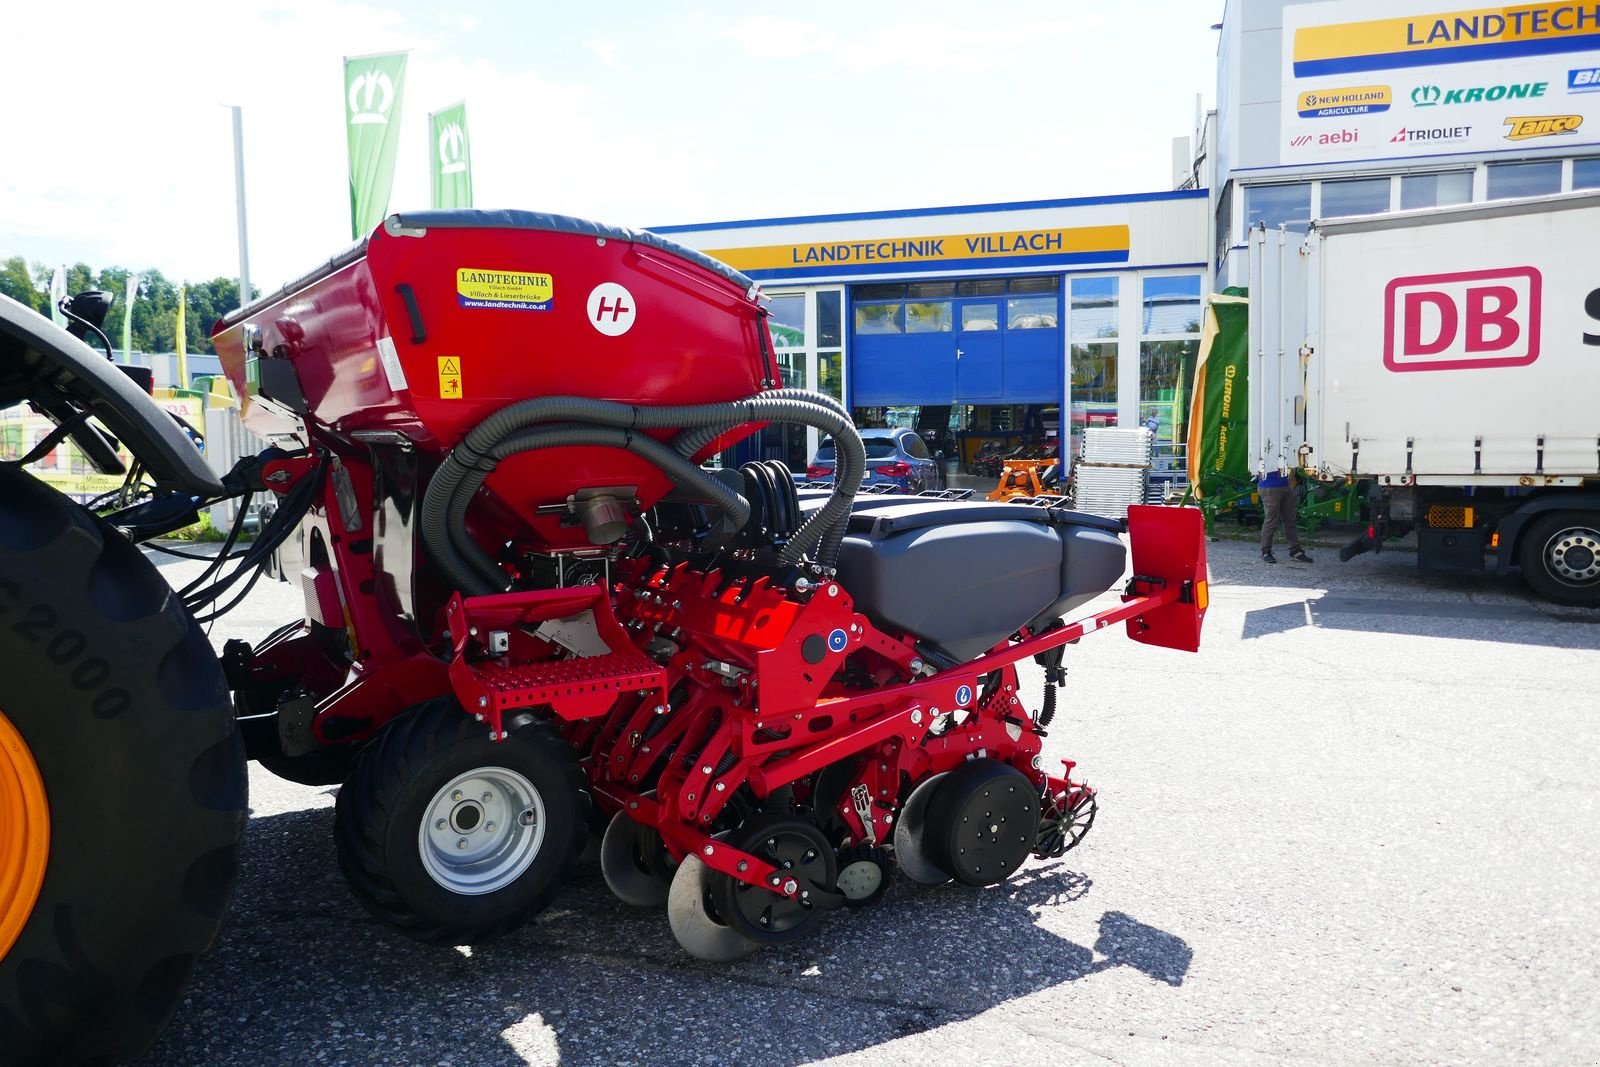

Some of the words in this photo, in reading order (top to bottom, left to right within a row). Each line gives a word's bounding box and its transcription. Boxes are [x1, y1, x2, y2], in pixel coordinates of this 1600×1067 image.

[1407, 5, 1600, 46] LANDTECH
[1573, 69, 1600, 86] Bi
[1319, 96, 1341, 104] NEW
[1342, 92, 1384, 102] HOLLAND
[1443, 82, 1549, 105] KRONE
[1318, 105, 1369, 116] AGRICULTURE
[1319, 128, 1359, 145] aebi
[1407, 126, 1472, 141] TRIOLIET
[1503, 115, 1584, 141] Tanco
[792, 239, 944, 263] LANDTECHNIK
[964, 232, 1062, 254] VILLACH
[461, 271, 548, 287] LANDTECHNIK
[500, 292, 541, 300] Lieserbrücke
[464, 300, 547, 310] www.landtechnik.co.at
[1403, 285, 1520, 356] DB
[1222, 379, 1232, 418] KRONE
